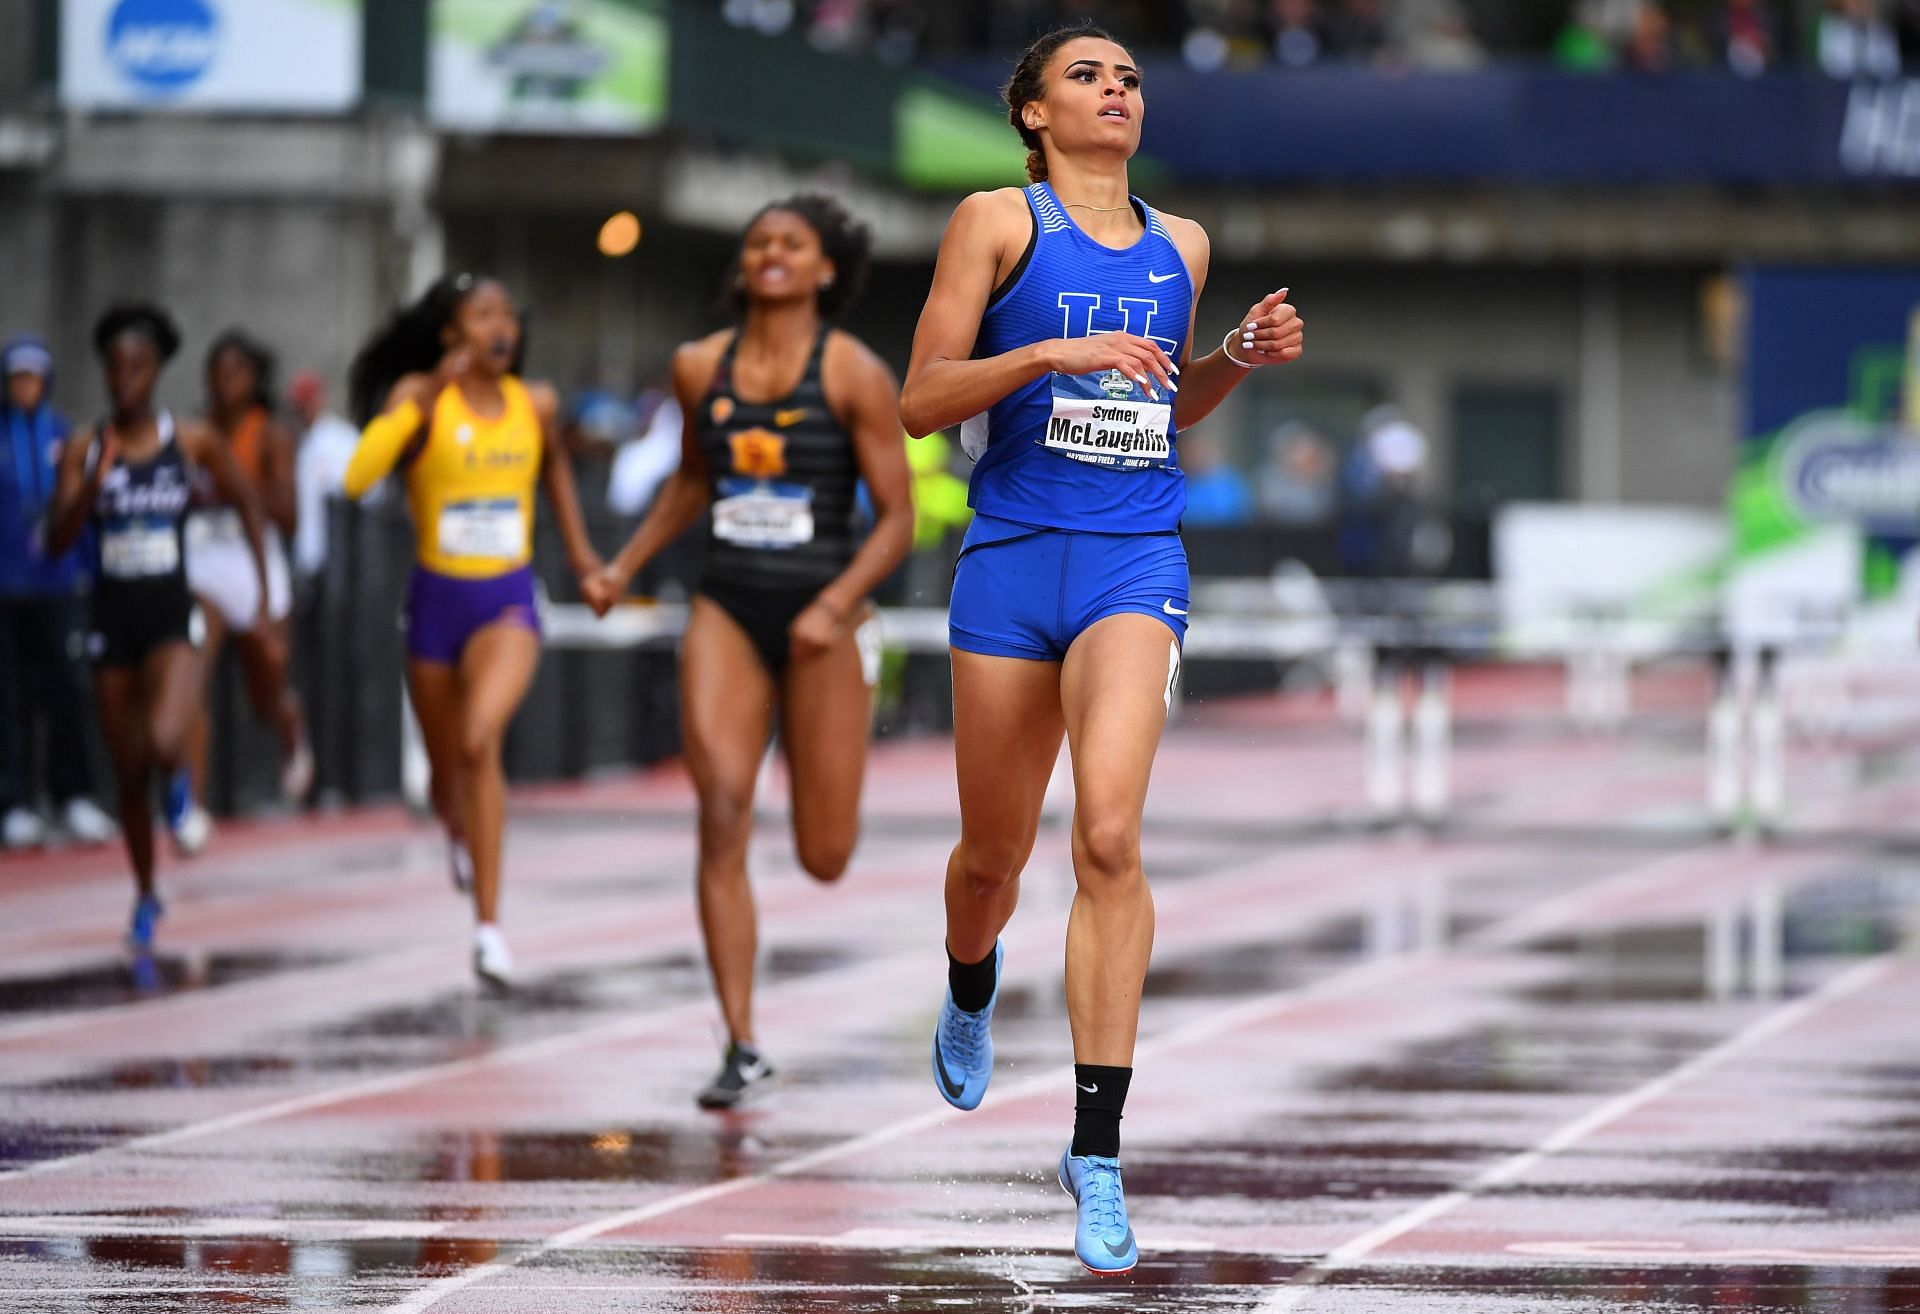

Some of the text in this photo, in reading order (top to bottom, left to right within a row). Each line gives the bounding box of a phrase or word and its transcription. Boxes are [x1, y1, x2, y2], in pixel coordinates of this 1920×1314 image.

[1092, 405, 1139, 425] Sydney
[1049, 417, 1167, 453] McLaughlin
[1066, 452, 1097, 463] HAYWARD
[1097, 455, 1116, 465] FIELD
[1122, 458, 1139, 467] JUNE
